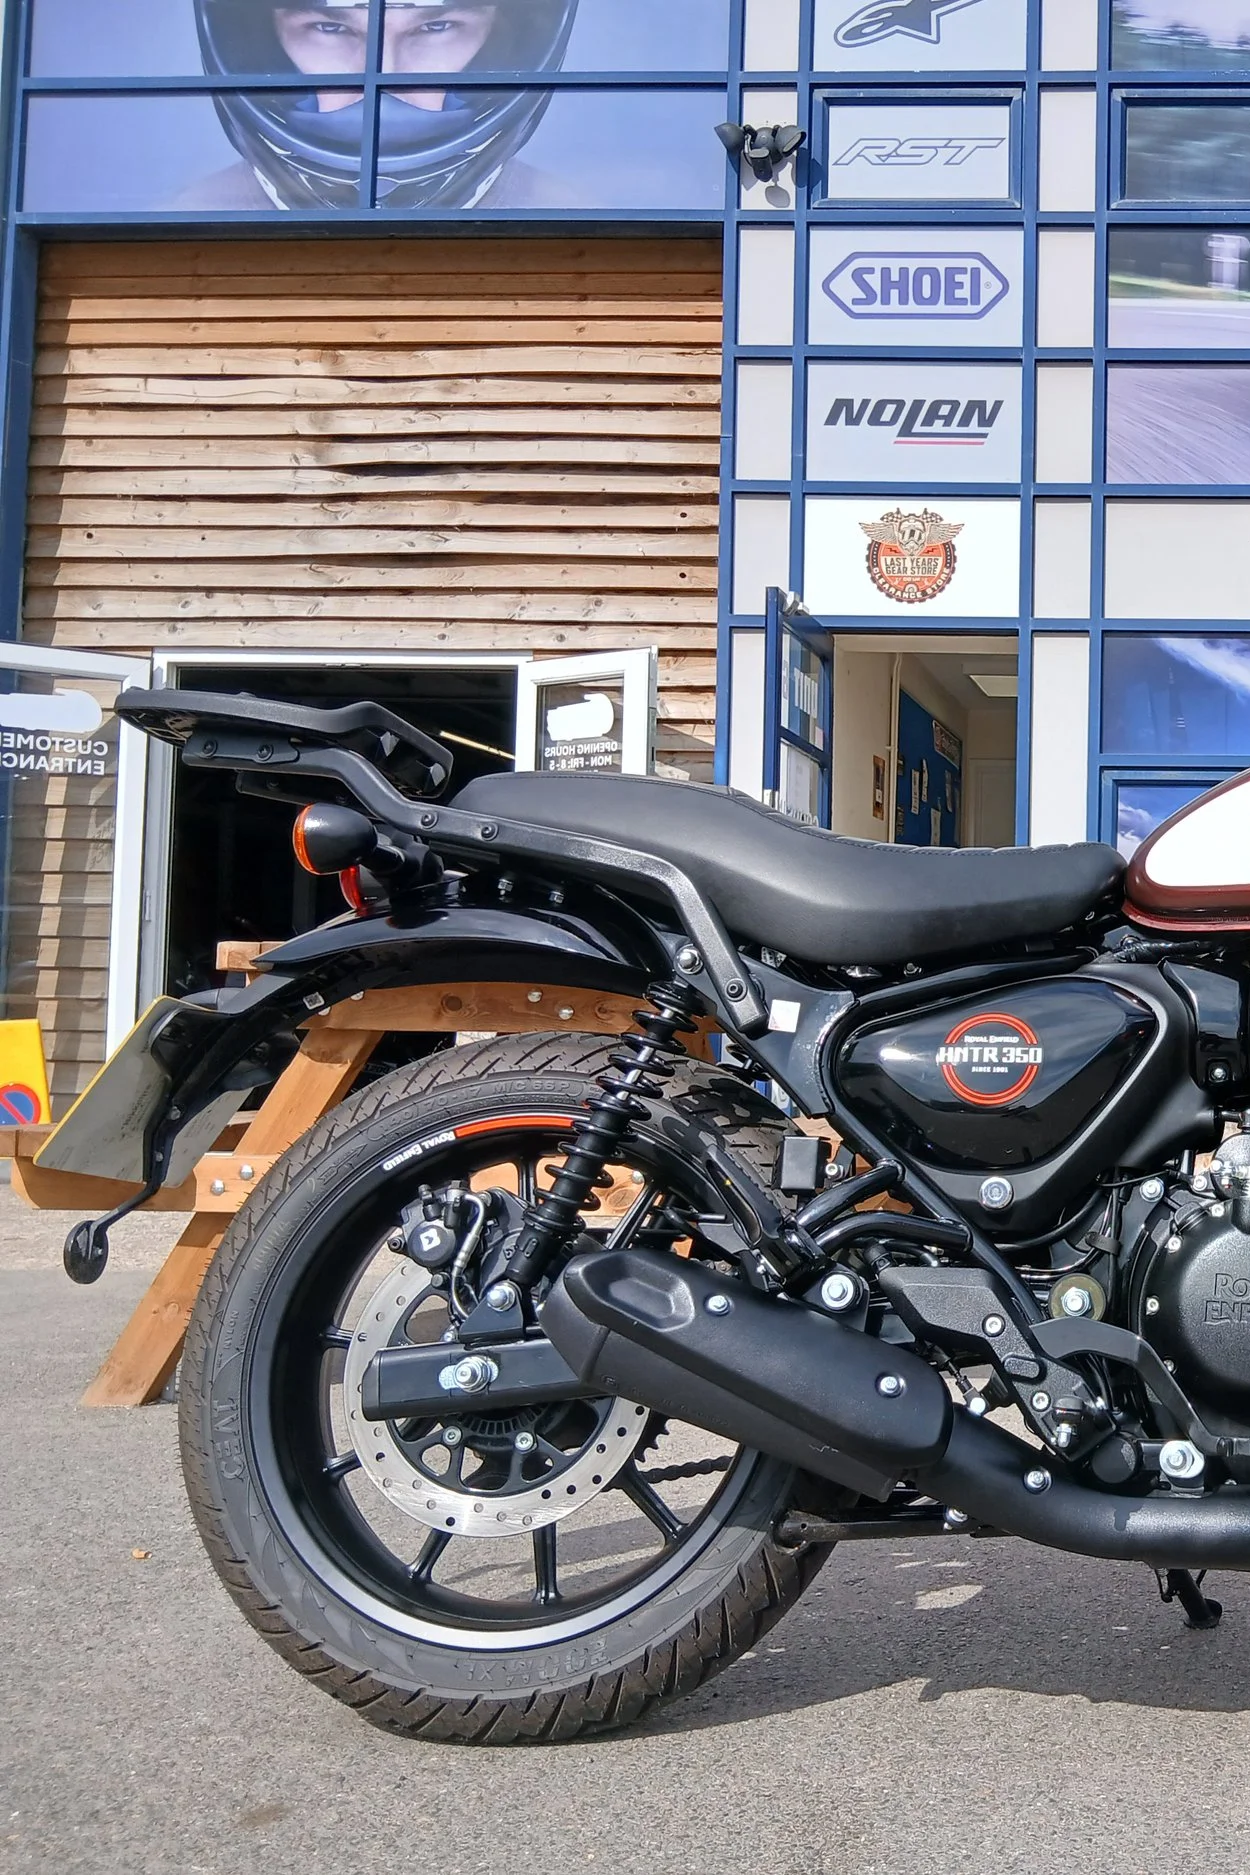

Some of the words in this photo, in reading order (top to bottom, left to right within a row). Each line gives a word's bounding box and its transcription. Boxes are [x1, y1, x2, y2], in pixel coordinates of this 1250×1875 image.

[832, 137, 1006, 166] RST
[851, 266, 981, 306] SHOEI
[823, 398, 1004, 439] NOLAN
[884, 557, 907, 567] LAST
[910, 557, 940, 567] YEARS
[885, 566, 908, 575] GEAR
[910, 566, 938, 575] STORE
[873, 566, 923, 599] CLEARANCE
[926, 567, 951, 595] STORE
[964, 1035, 989, 1043] ROYAL
[939, 1046, 999, 1063] HNTR
[1001, 1046, 1043, 1064] 350
[421, 1131, 456, 1150] ROYAL
[382, 1142, 423, 1172] ENFIELD
[212, 1400, 246, 1481] CEAT
